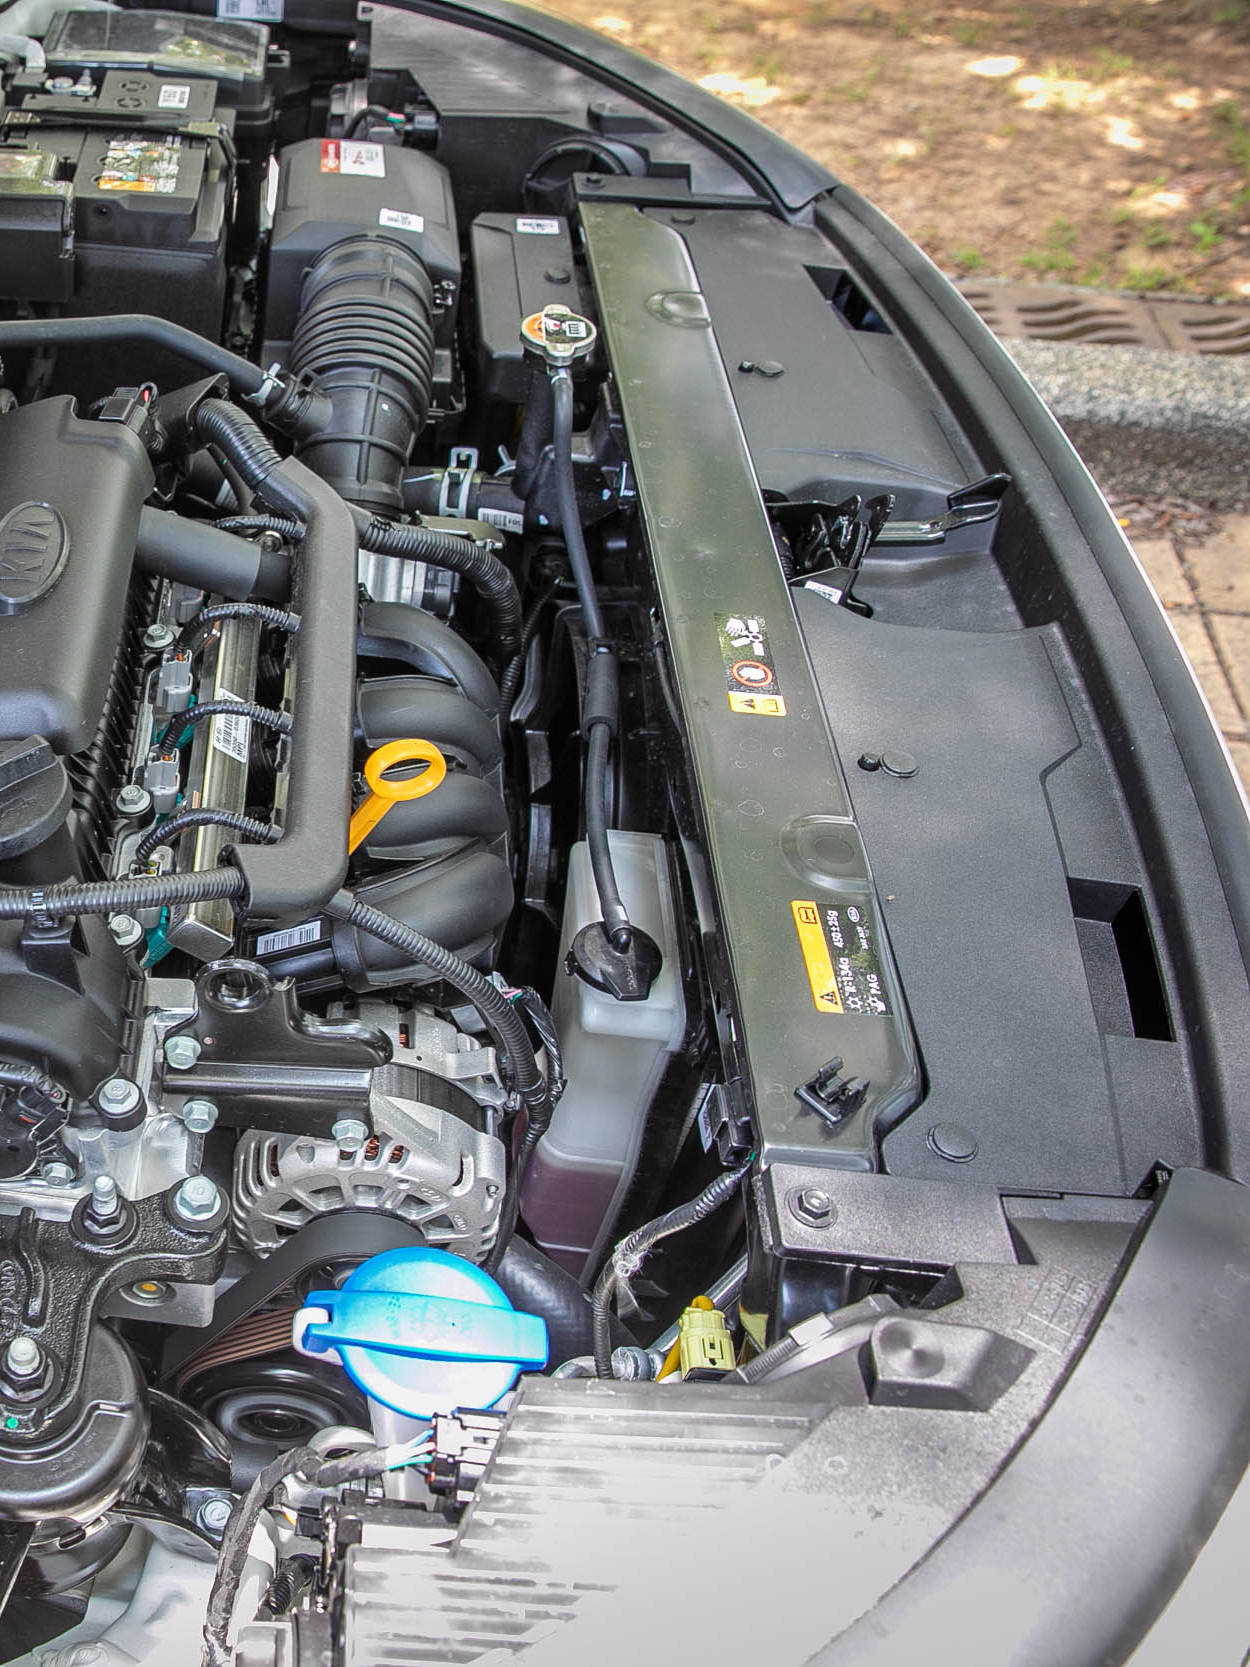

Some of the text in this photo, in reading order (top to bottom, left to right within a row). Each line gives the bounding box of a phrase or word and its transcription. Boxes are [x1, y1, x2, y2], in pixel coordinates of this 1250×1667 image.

[826, 910, 857, 993] R-134a 450±25g
[866, 973, 882, 995] PAG
